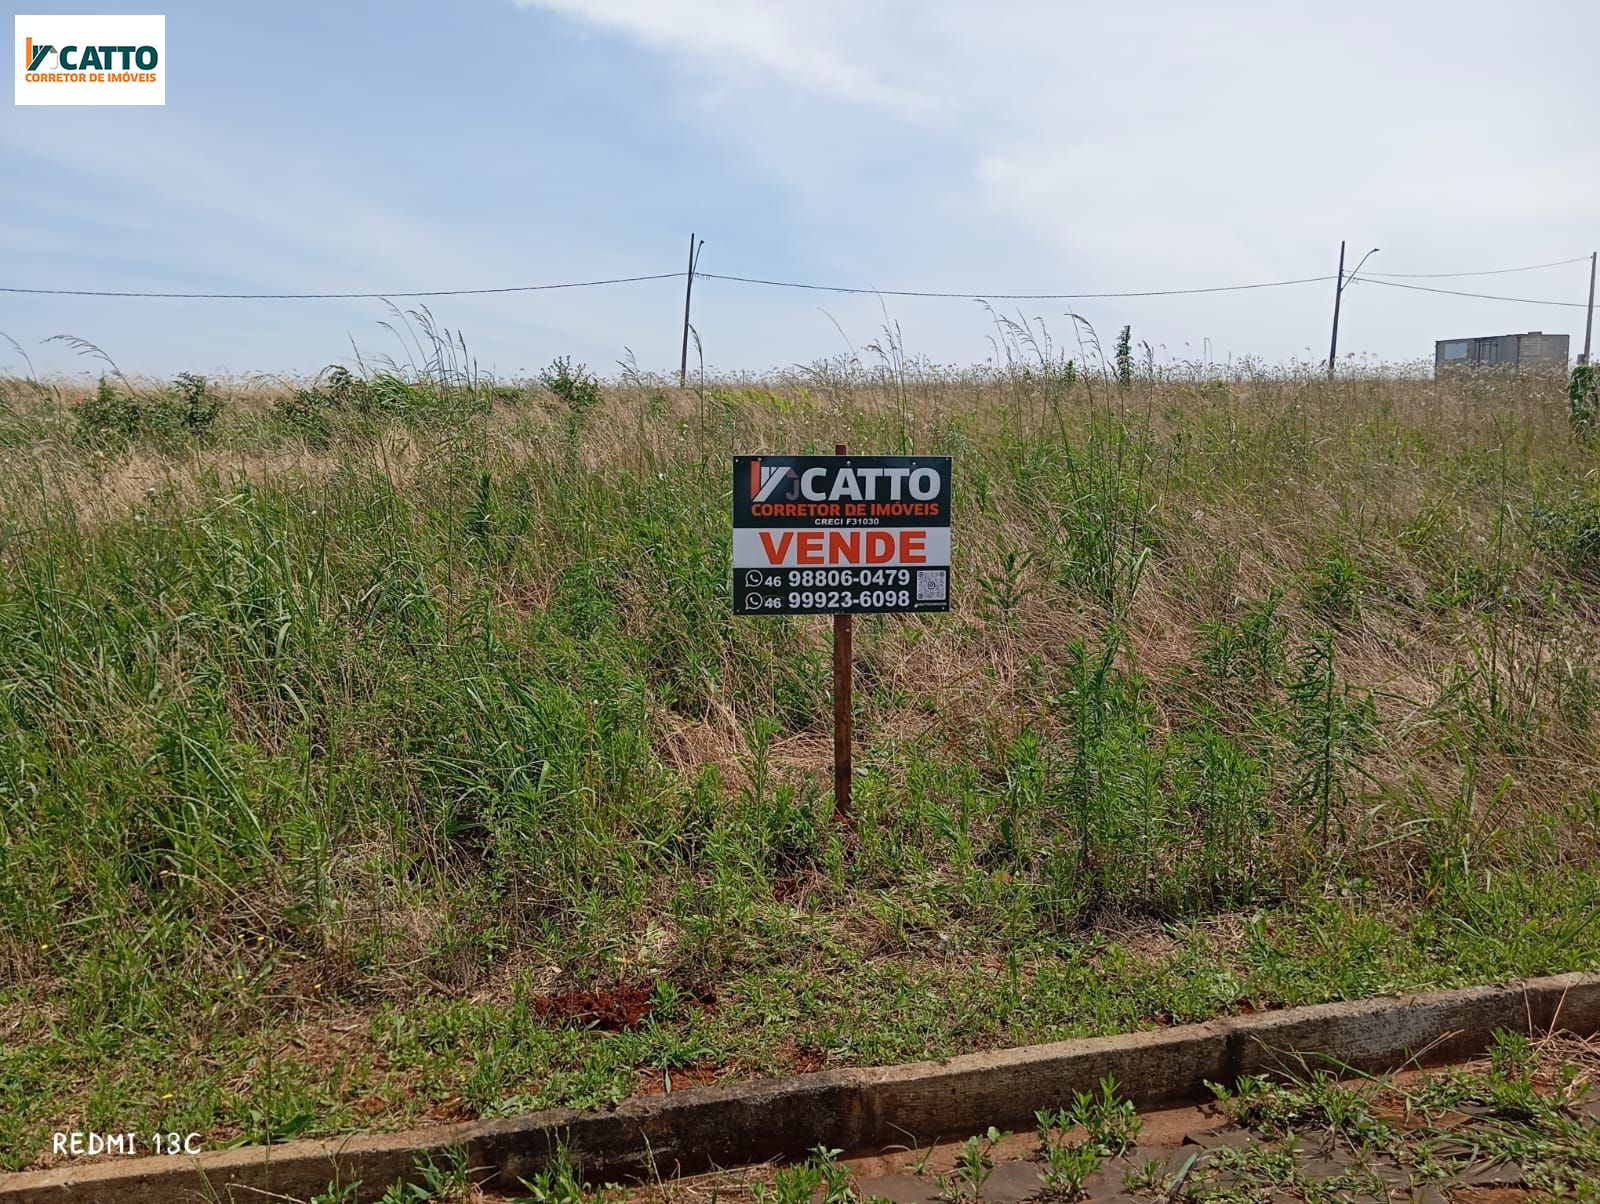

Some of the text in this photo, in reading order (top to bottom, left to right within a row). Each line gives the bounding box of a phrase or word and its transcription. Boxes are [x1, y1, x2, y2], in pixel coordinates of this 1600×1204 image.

[800, 467, 941, 501] CATTO
[751, 501, 939, 516] CORRETOR DE IMÓVEIS
[759, 531, 927, 565] VENDE
[764, 569, 910, 587] 46 98806-0479
[764, 591, 910, 608] 46 99923-6098
